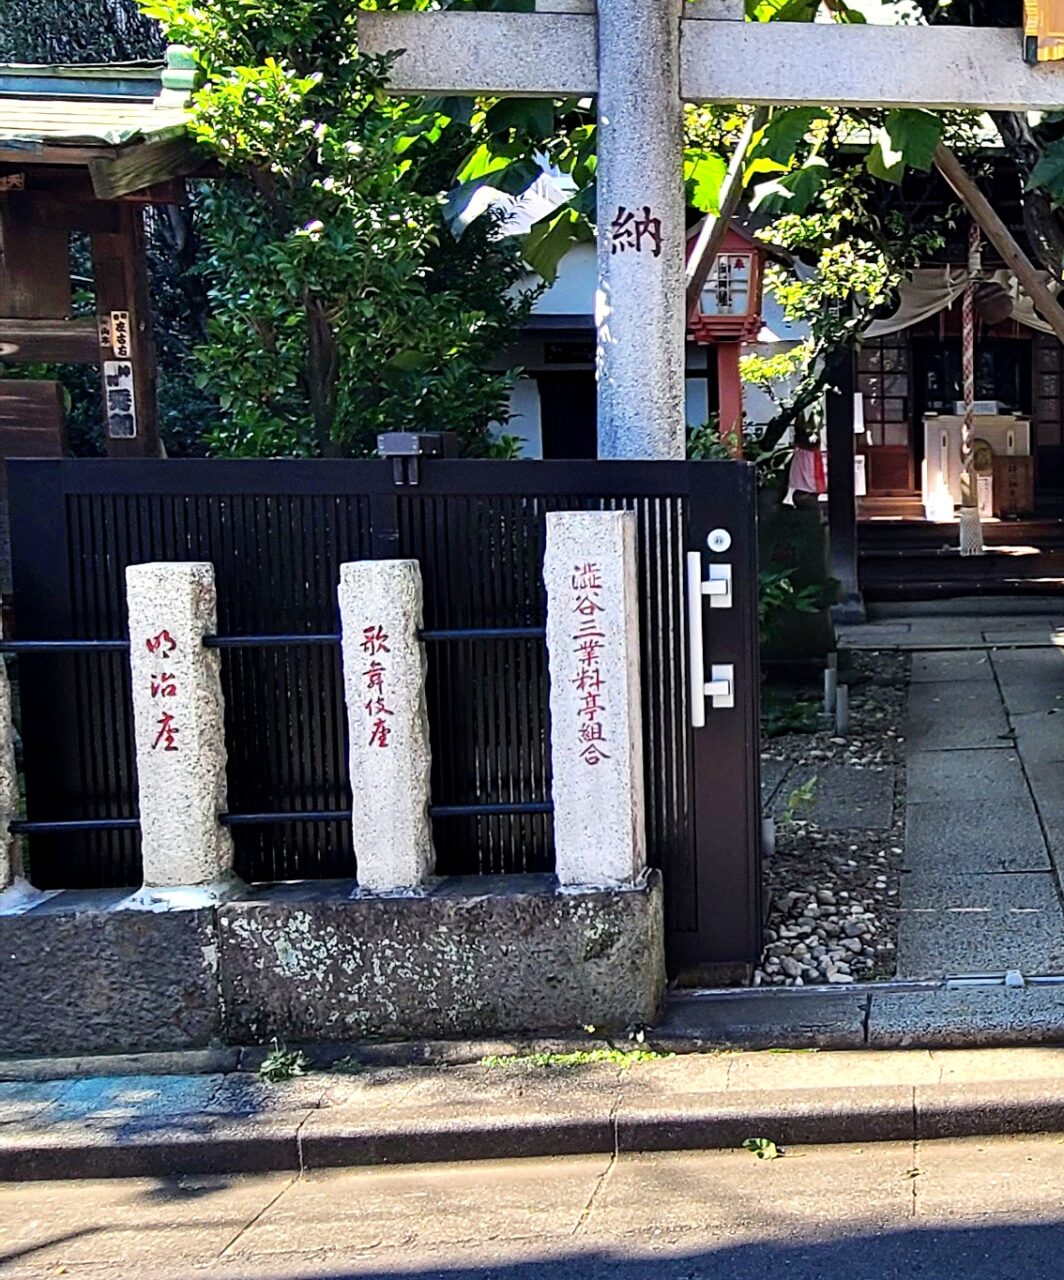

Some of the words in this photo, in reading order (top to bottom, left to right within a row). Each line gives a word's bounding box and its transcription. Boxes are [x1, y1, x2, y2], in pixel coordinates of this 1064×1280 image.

[611, 205, 665, 258] 納
[145, 629, 180, 752] 明治座
[359, 624, 395, 748] 歌舞伎座
